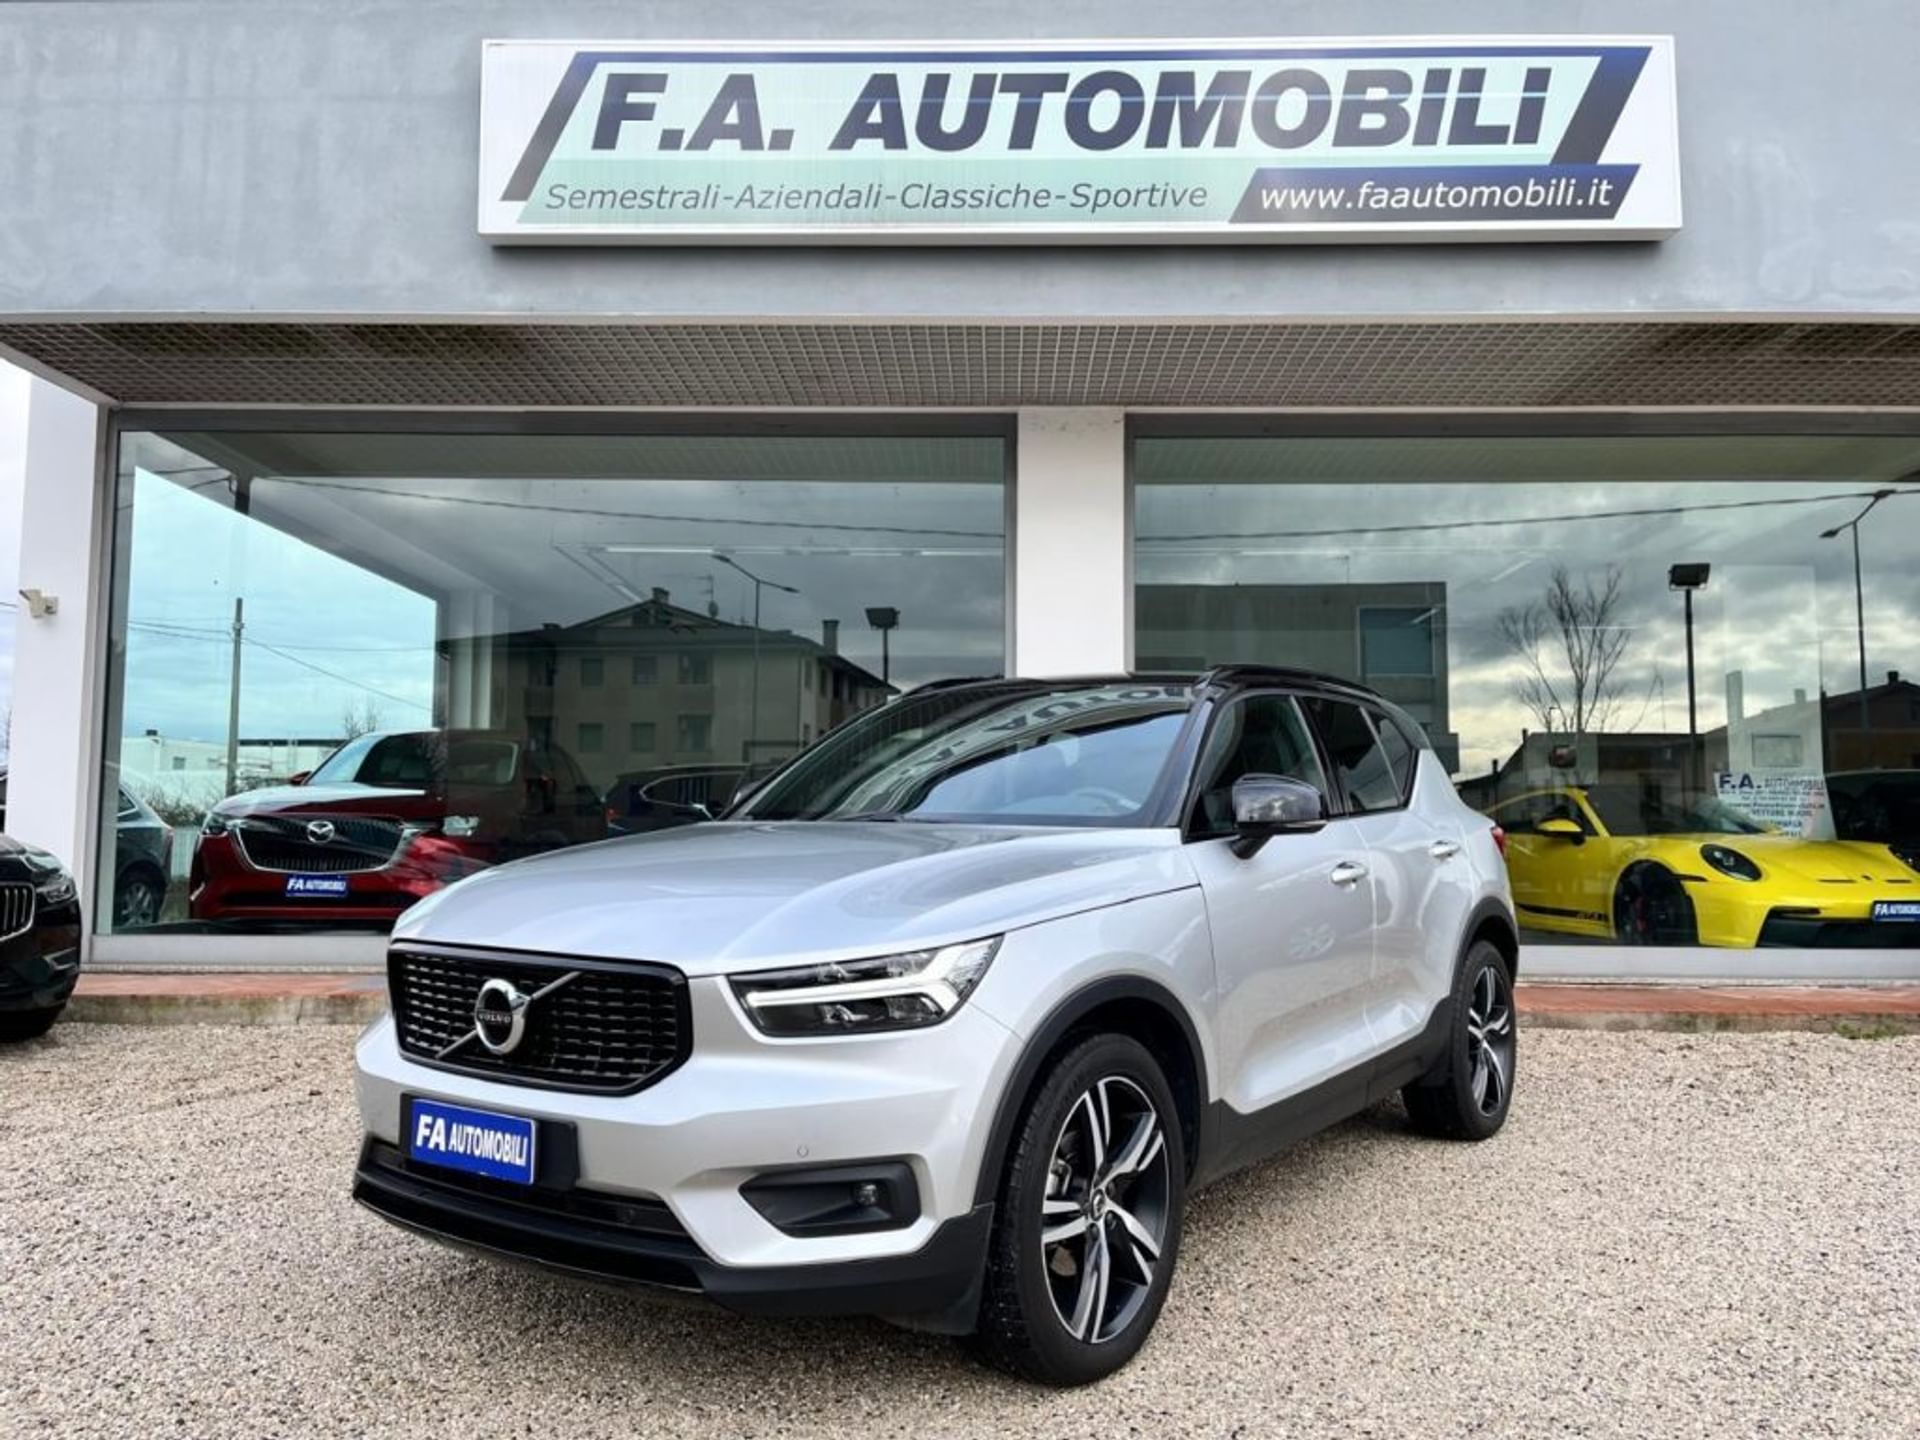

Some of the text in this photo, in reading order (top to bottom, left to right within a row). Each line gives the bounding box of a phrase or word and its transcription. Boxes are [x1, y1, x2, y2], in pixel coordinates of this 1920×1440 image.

[591, 67, 1552, 151] F.A. AUTOMOBILI
[1261, 178, 1613, 210] www.faautomobili.it
[287, 878, 304, 891] FA
[1875, 904, 1889, 916] FA
[478, 1013, 512, 1024] VOLVO
[416, 1114, 528, 1166] FA AUTOMOBILI
